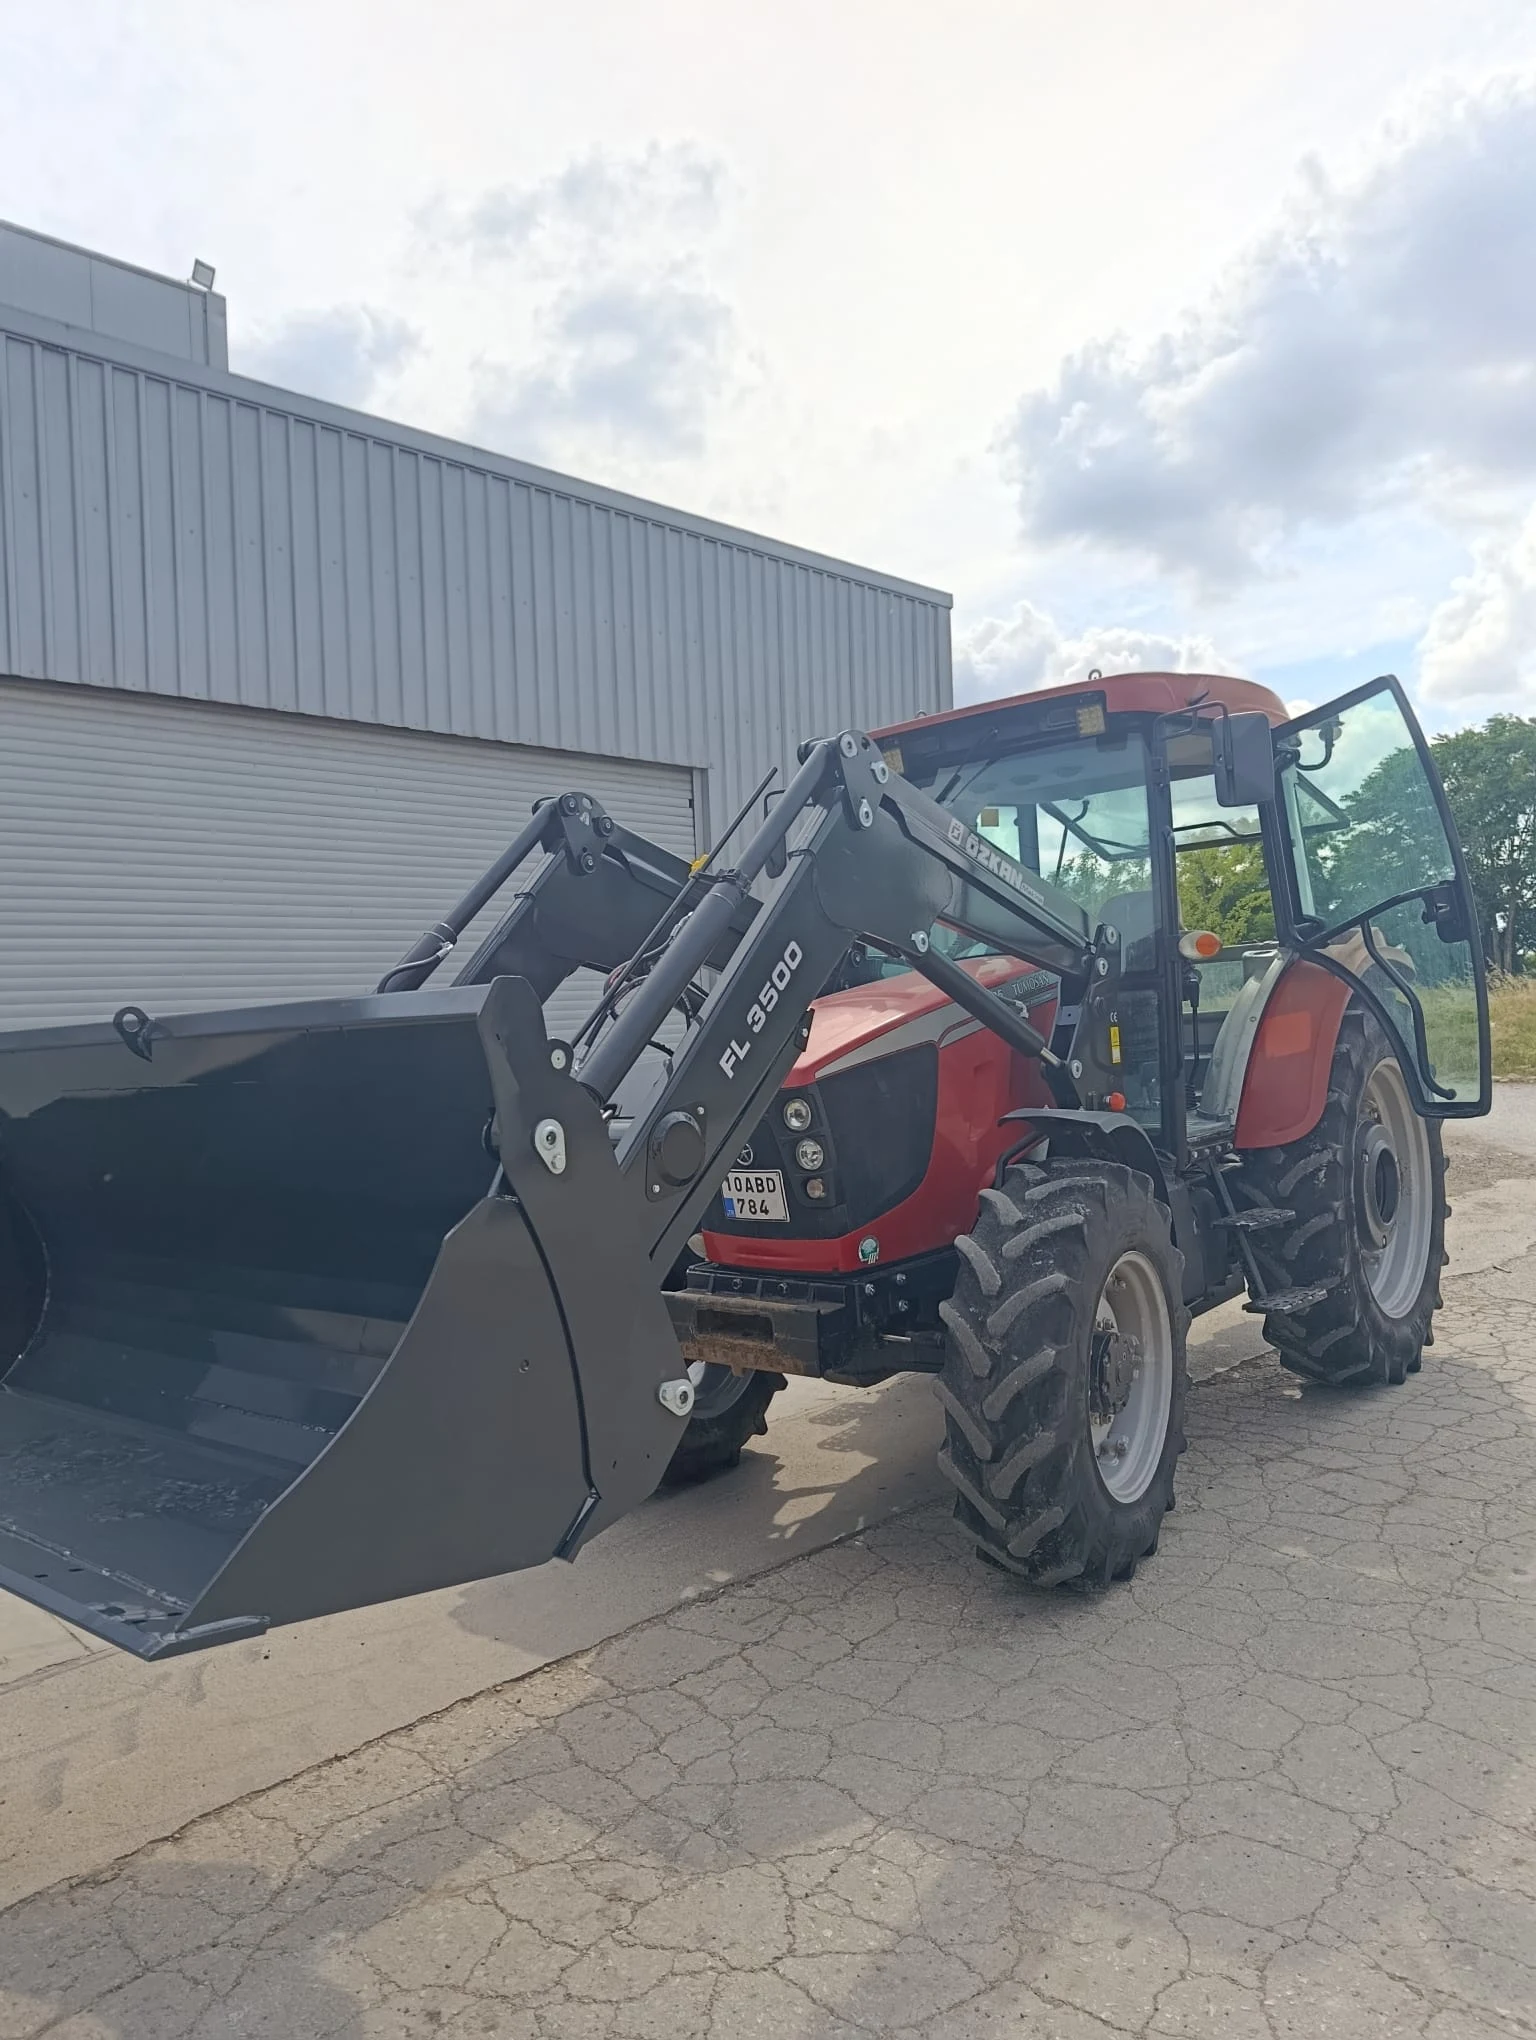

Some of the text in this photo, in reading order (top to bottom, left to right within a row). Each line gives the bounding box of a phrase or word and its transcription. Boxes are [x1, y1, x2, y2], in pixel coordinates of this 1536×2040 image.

[965, 832, 1023, 890] ÖZKAN
[719, 940, 803, 1079] FL 3500
[737, 1199, 770, 1215] 784
